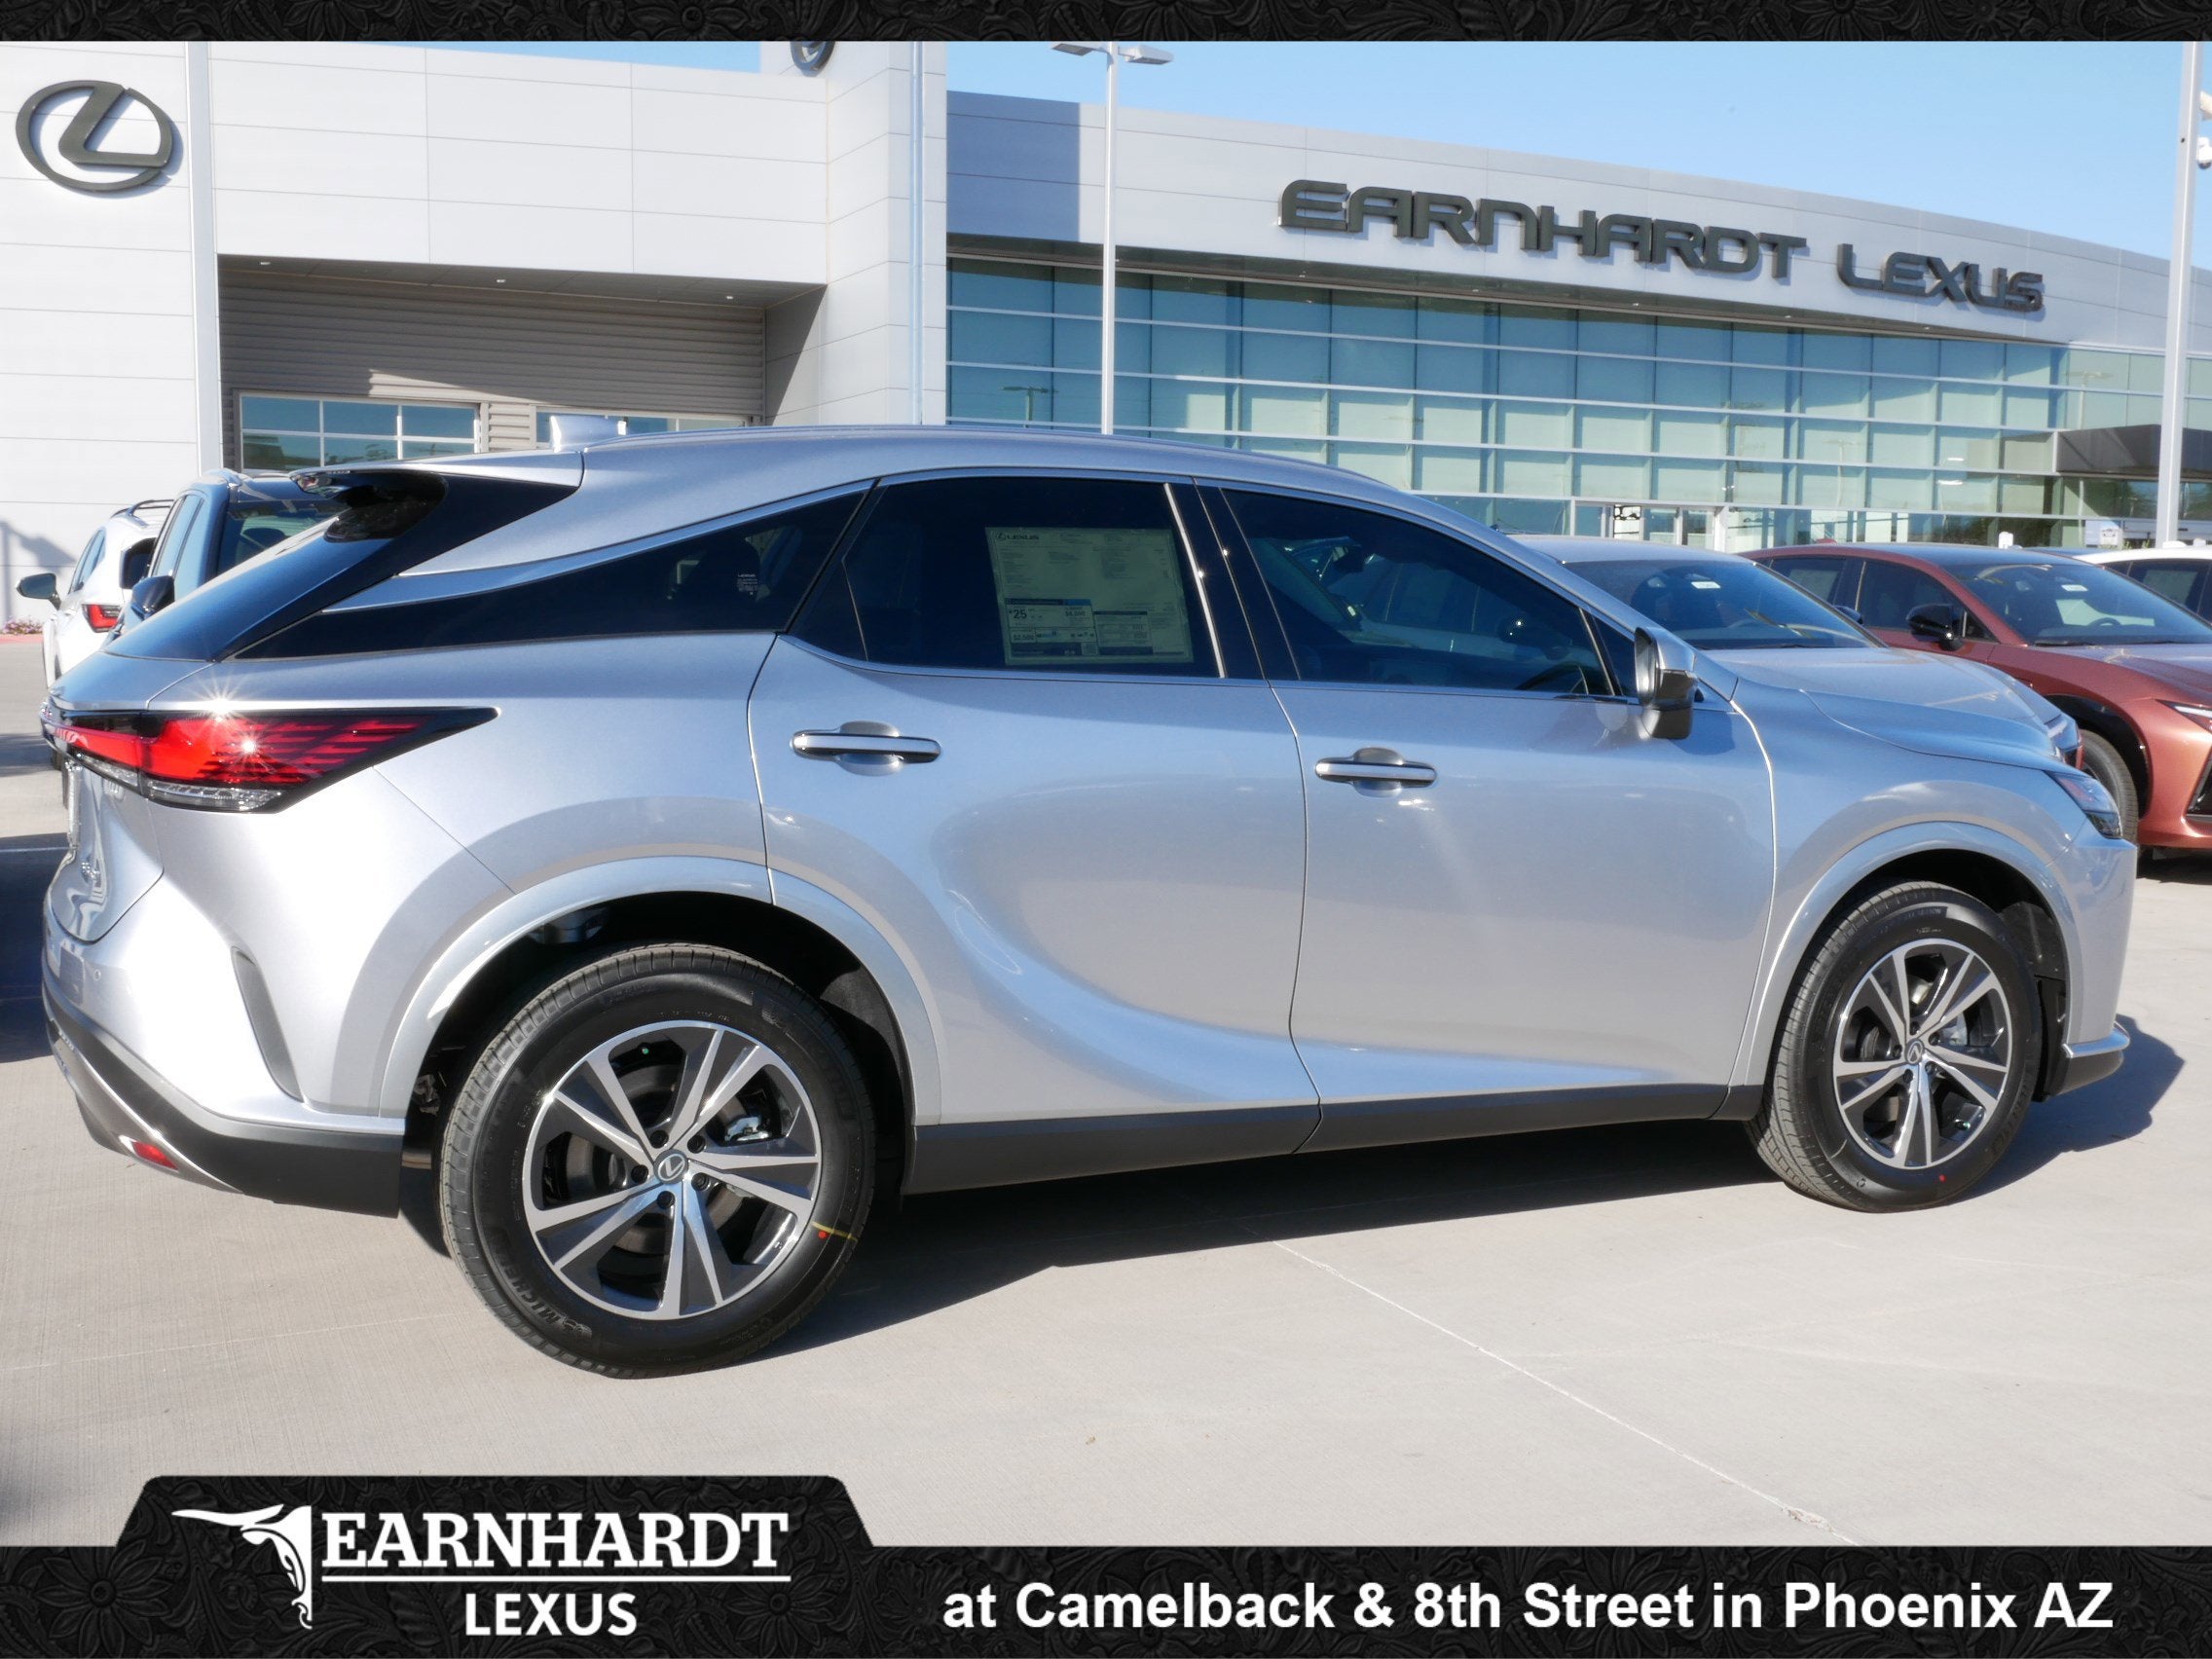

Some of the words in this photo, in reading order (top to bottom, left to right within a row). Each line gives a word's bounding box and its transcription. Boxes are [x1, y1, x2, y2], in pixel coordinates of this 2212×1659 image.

[1278, 179, 1807, 278] EARNHARDT
[1837, 243, 2043, 312] LEXUS
[1014, 608, 1027, 619] 25
